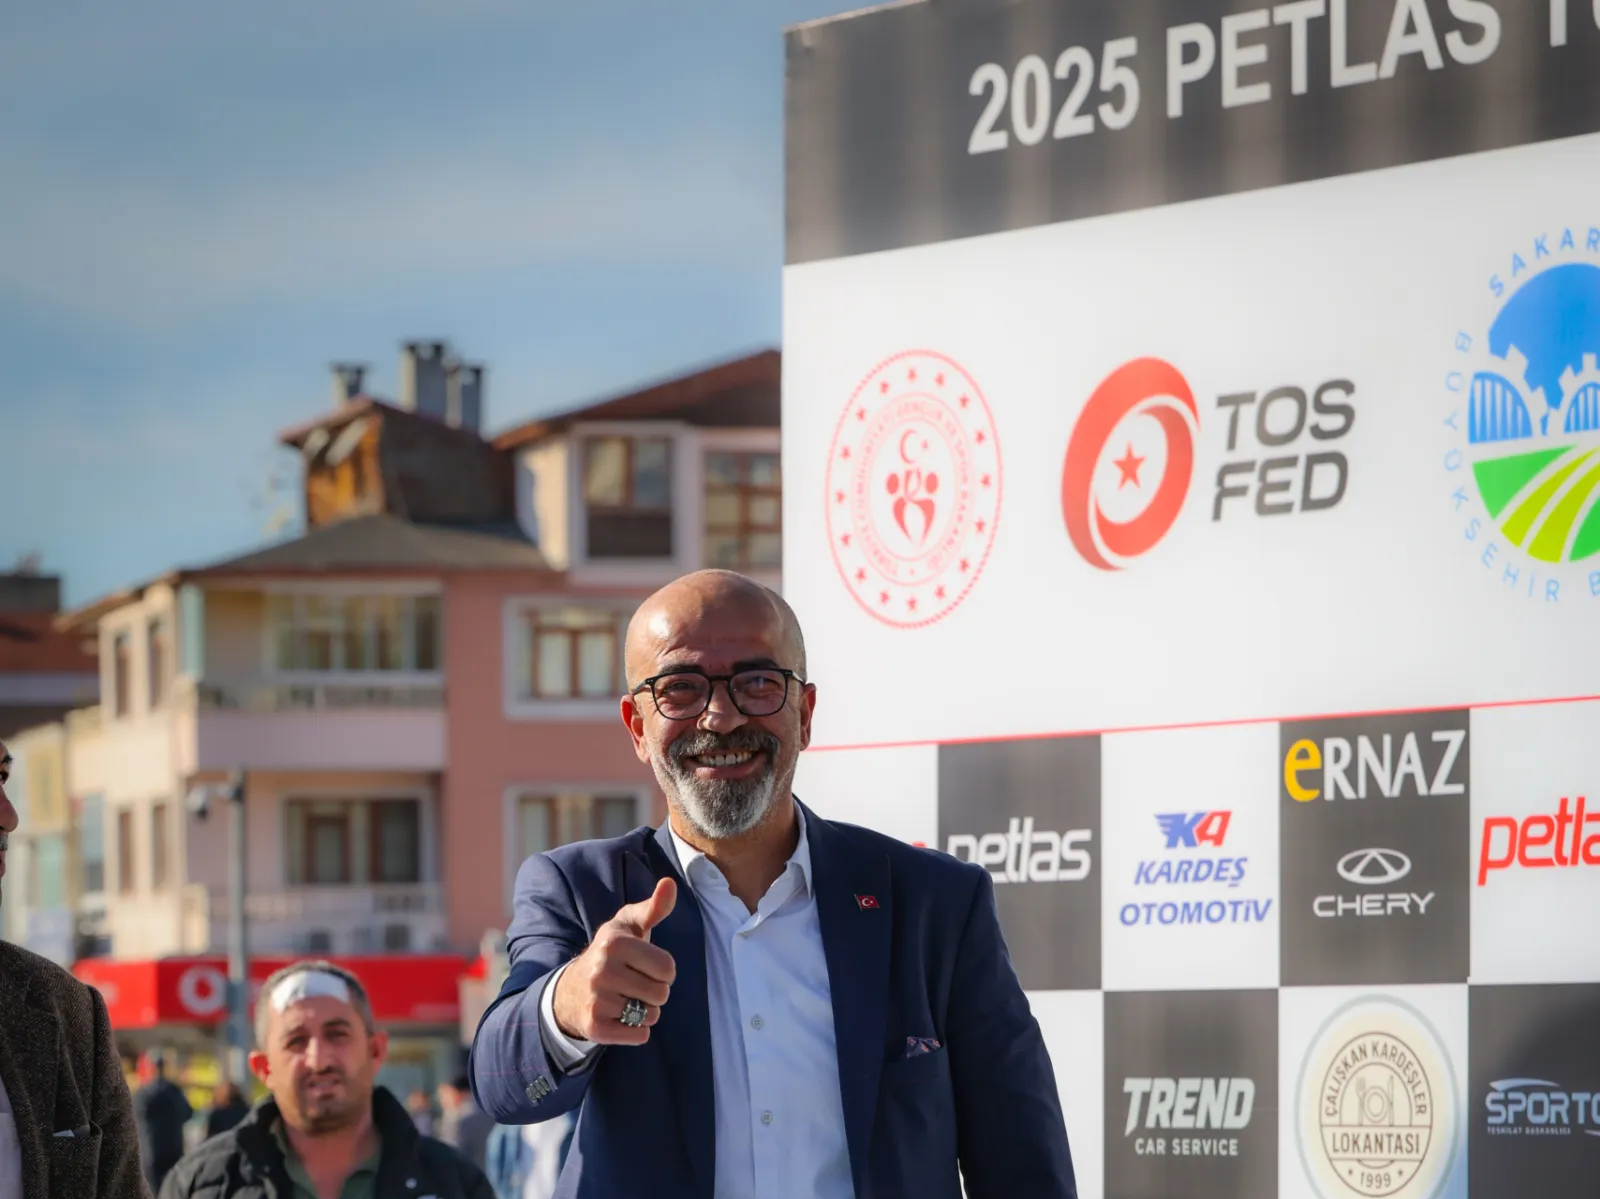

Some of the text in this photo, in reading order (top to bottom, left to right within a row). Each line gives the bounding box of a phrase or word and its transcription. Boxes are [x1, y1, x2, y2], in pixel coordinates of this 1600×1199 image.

[967, 36, 1140, 155] 2025
[1166, 0, 1501, 119] PETLAS
[1215, 379, 1355, 452] TOS
[1211, 451, 1349, 523] FED
[1284, 730, 1466, 803] eRNAZ
[1153, 810, 1232, 849] KA
[1133, 857, 1248, 888] KARDEŞ
[1312, 891, 1436, 918] CHERY
[1122, 1077, 1255, 1137] TREND
[1134, 1137, 1239, 1157] CAR SERVICE
[1332, 1132, 1420, 1154] LOKANTASI
[1360, 1171, 1392, 1189] 1999
